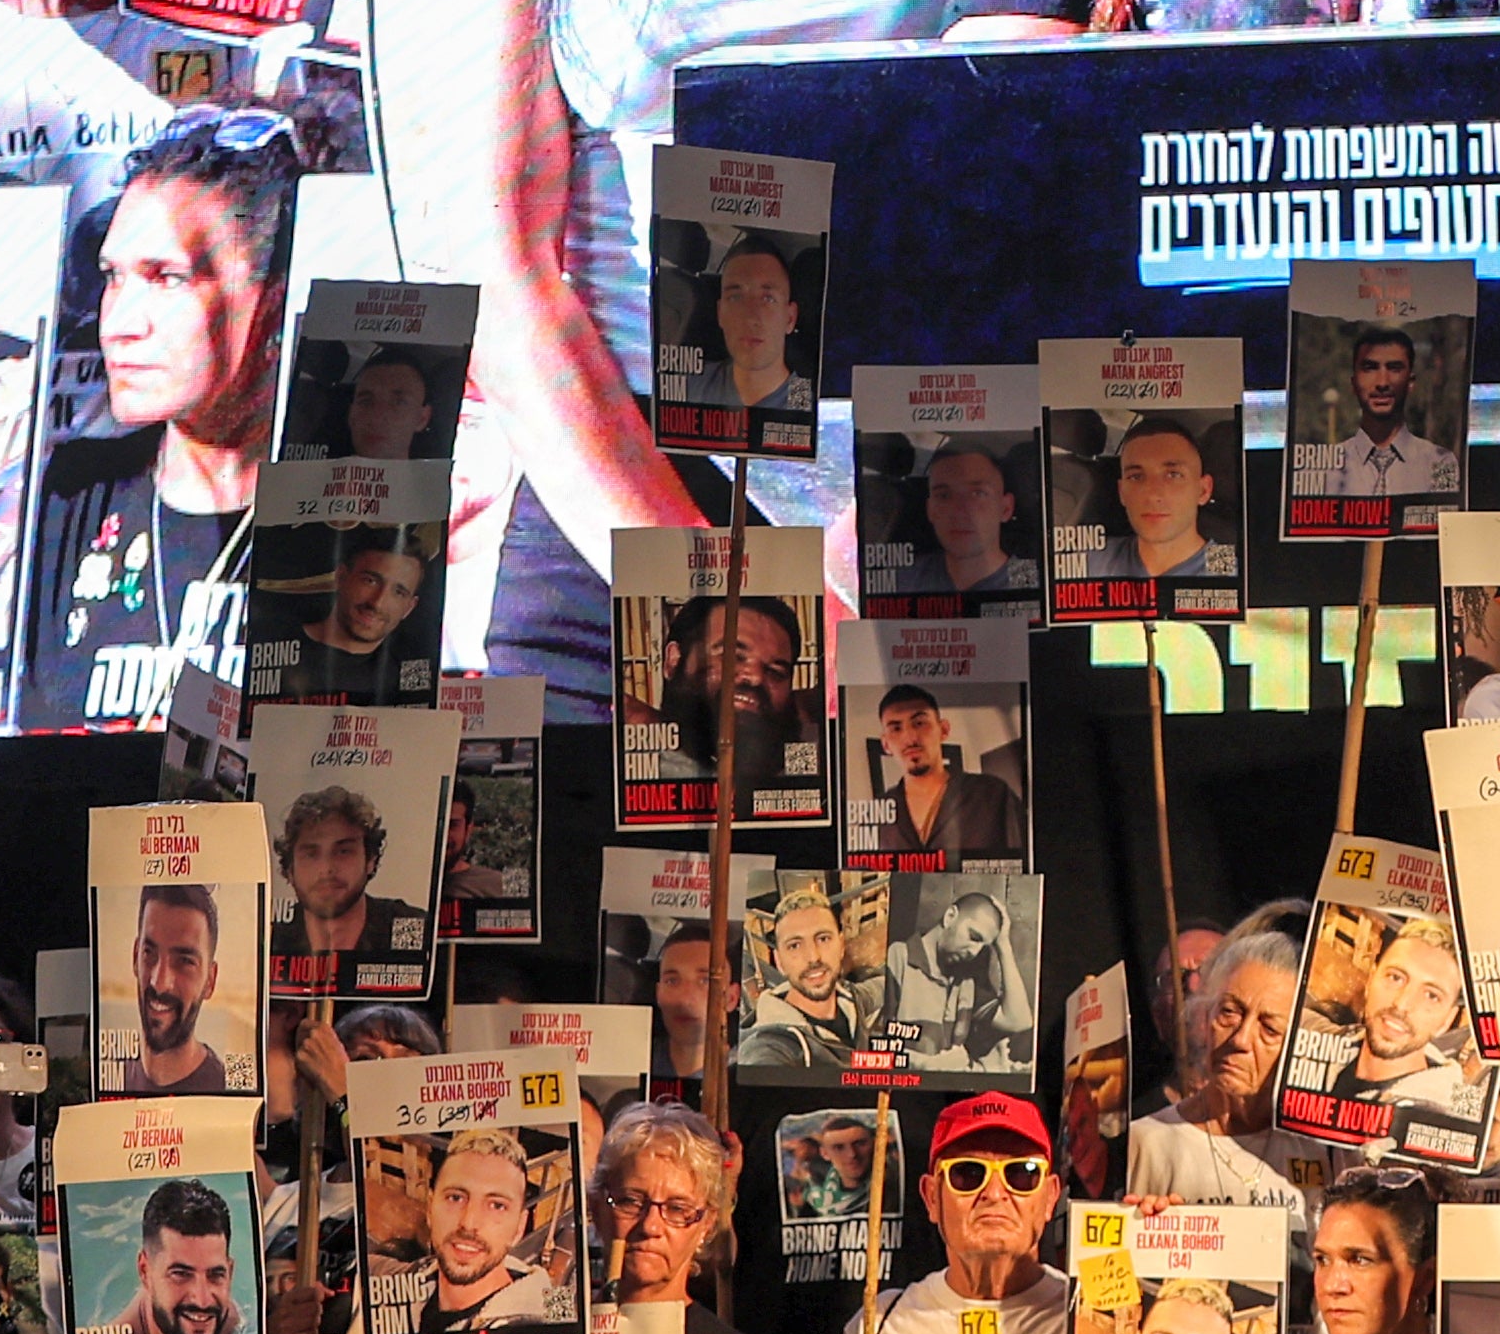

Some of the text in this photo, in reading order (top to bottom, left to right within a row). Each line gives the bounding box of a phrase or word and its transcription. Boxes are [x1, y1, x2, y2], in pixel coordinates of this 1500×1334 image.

[1140, 121, 1275, 186] להחזרת
[1282, 123, 1458, 182] המשפחות
[709, 177, 783, 199] MATAN ANGREST
[1140, 189, 1341, 261] והנעדרים
[1102, 363, 1185, 381] MATAN ANGREST
[1053, 524, 1106, 551] BRING
[1053, 550, 1088, 579] HIM
[1055, 579, 1157, 609] HOME NOW!
[326, 731, 379, 748] ALON OHEL
[145, 814, 185, 837] גלי ברמן
[153, 834, 200, 855] BERMAN
[425, 1061, 505, 1085] אלקנה בוחבוט
[419, 1078, 512, 1102] ELKANA BOHBOT
[522, 1074, 560, 1107] 673
[122, 1127, 184, 1150] ZIV BERMAN
[1086, 1214, 1126, 1245] 673
[1136, 1232, 1226, 1252] ELKANA BOHBOT
[369, 1273, 430, 1305] BRING
